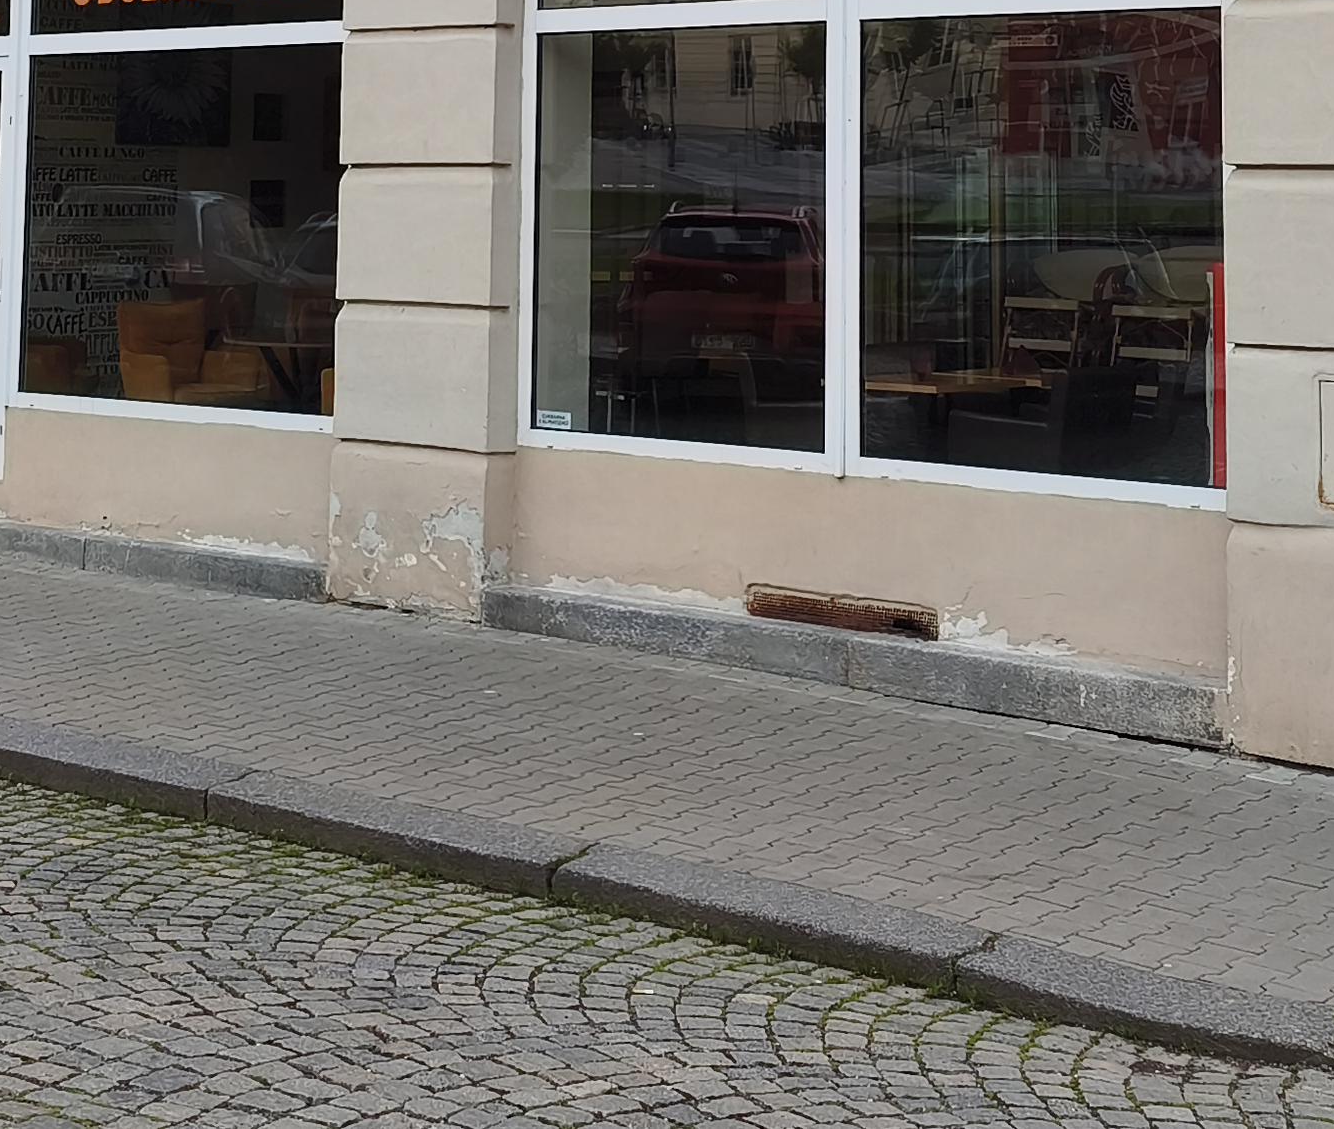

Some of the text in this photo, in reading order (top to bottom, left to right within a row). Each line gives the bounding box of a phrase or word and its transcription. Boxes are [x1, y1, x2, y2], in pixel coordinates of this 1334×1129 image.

[59, 167, 98, 183] LATTE
[142, 167, 178, 183] CAFFE
[55, 233, 102, 246] ESPRESSO
